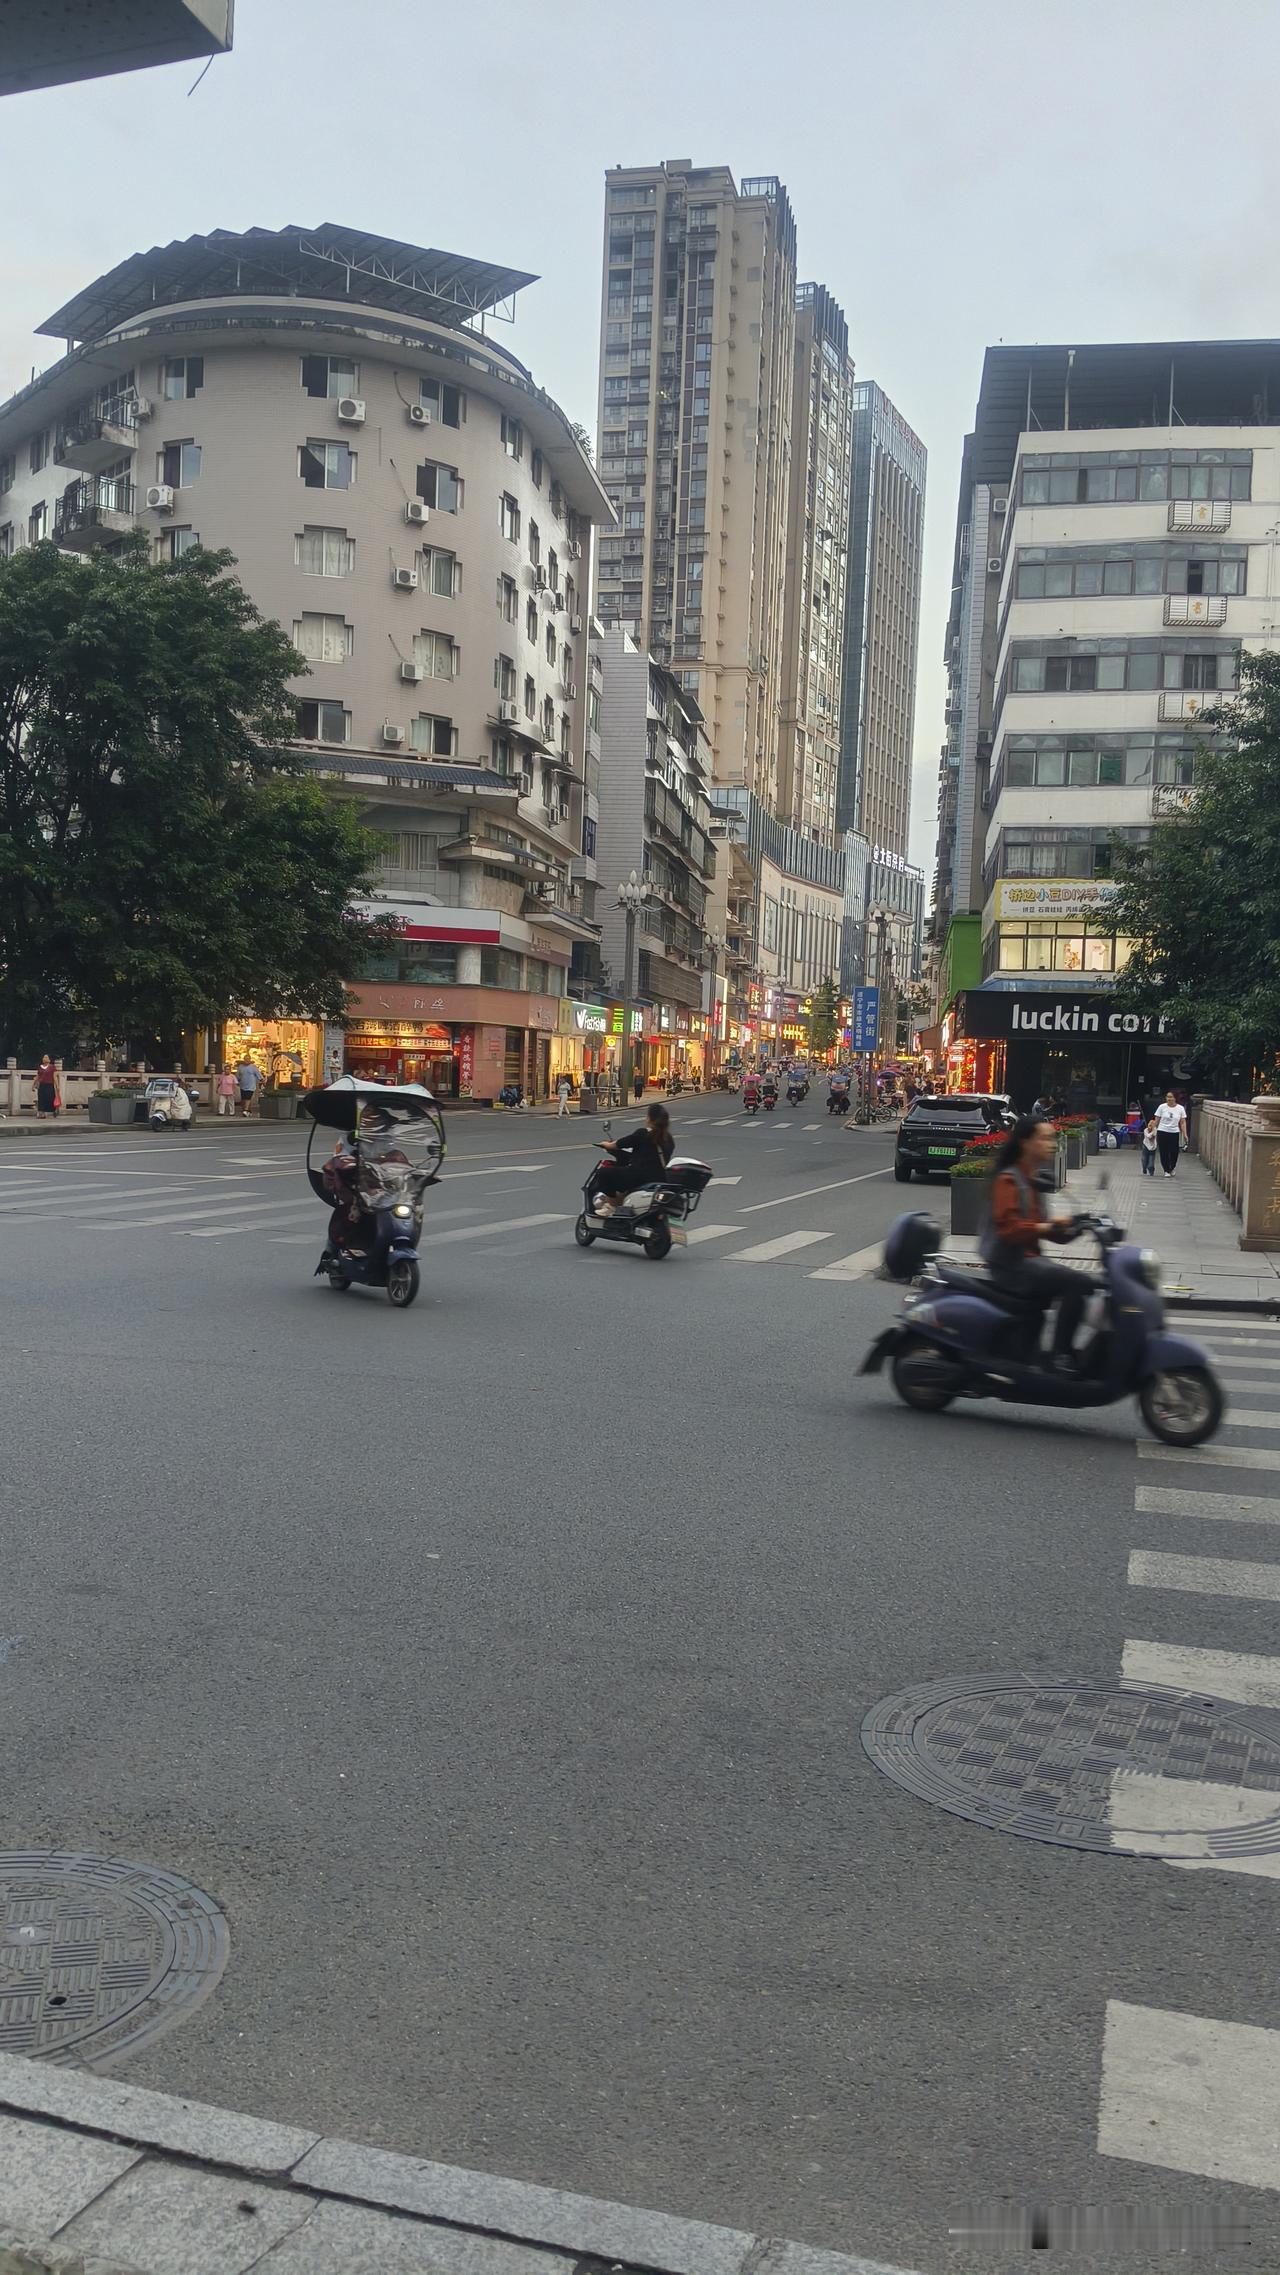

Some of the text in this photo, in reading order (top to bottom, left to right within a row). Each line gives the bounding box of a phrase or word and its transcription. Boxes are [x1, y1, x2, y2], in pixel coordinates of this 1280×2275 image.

[1008, 888, 1120, 902] 桥边小豆DIY手作
[866, 1001, 876, 1037] 严管街
[1012, 1004, 1099, 1031] luckin
